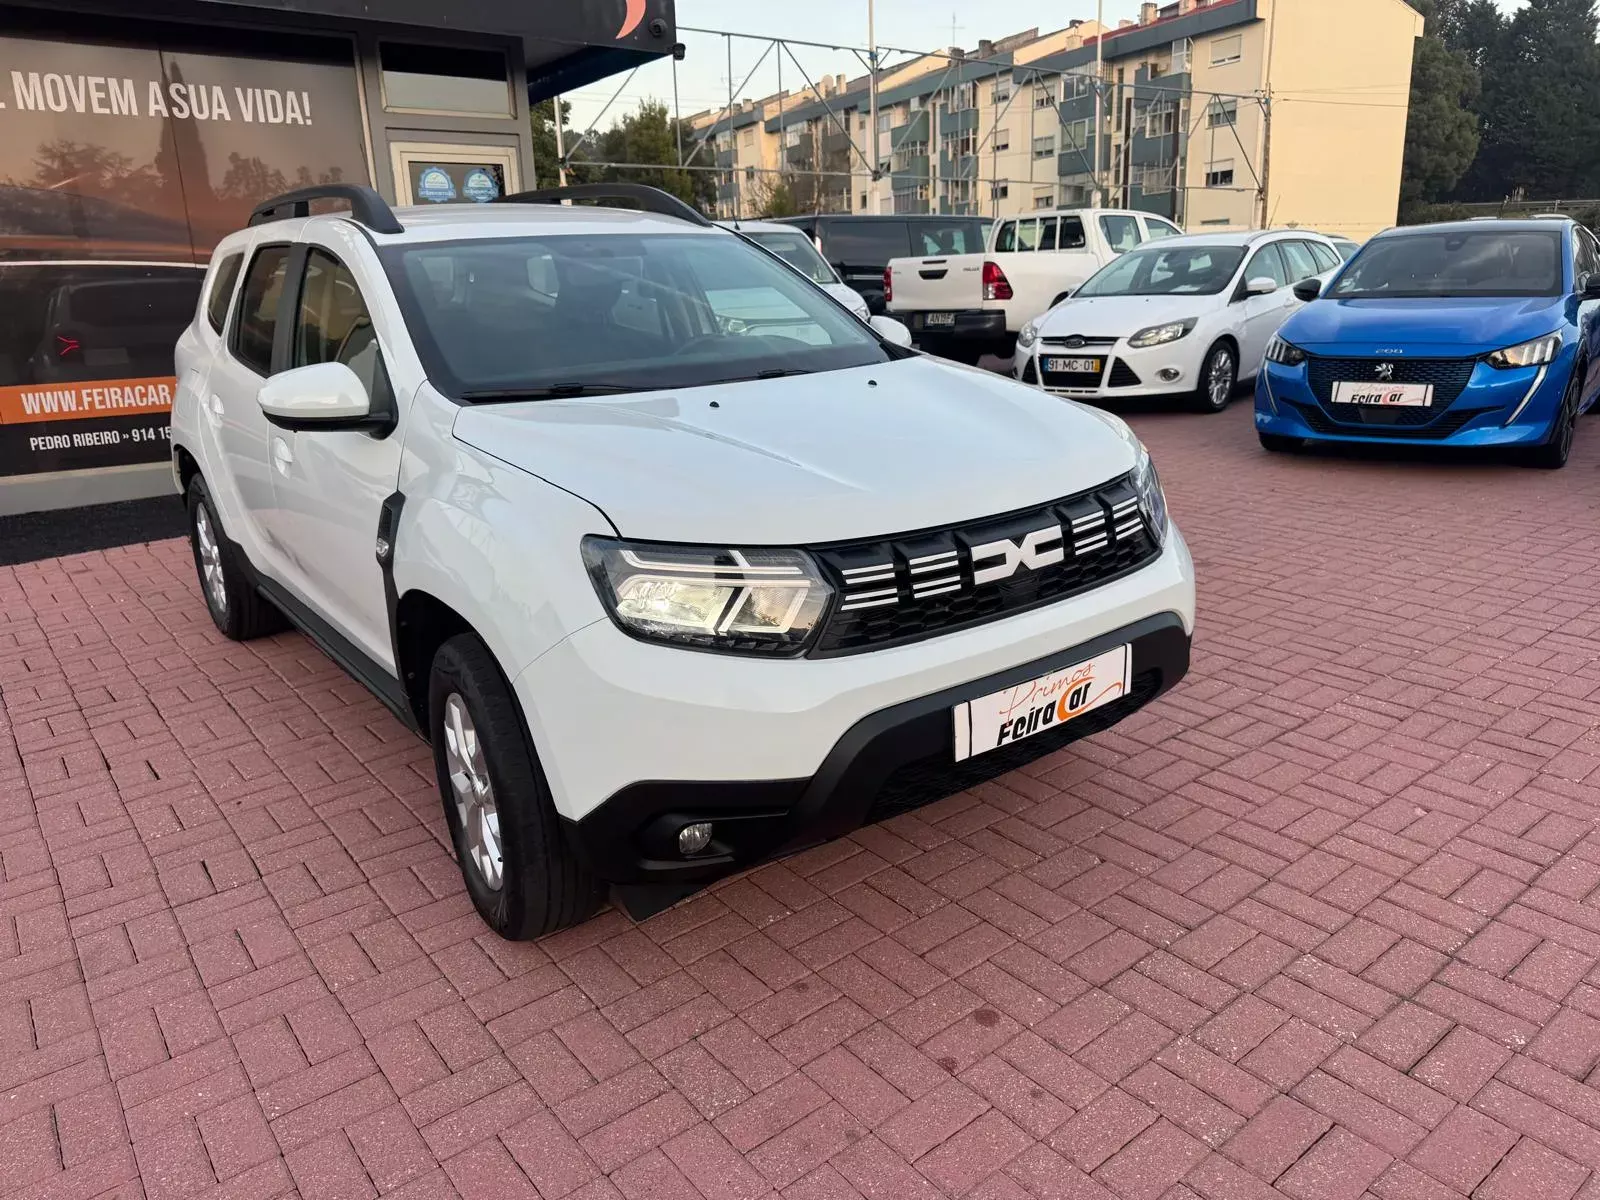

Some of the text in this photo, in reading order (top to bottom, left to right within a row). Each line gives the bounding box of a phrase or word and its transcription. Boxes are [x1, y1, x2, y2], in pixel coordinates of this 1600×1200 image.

[10, 70, 139, 117] MOVEM
[234, 87, 312, 125] VIDA!
[1048, 359, 1094, 372] 91-MC-01
[20, 384, 178, 415] WWW.FEIRACAR
[30, 434, 71, 451] PEDRO
[73, 430, 120, 448] RIBEIRO
[133, 427, 156, 443] 914
[999, 662, 1096, 724] Primos
